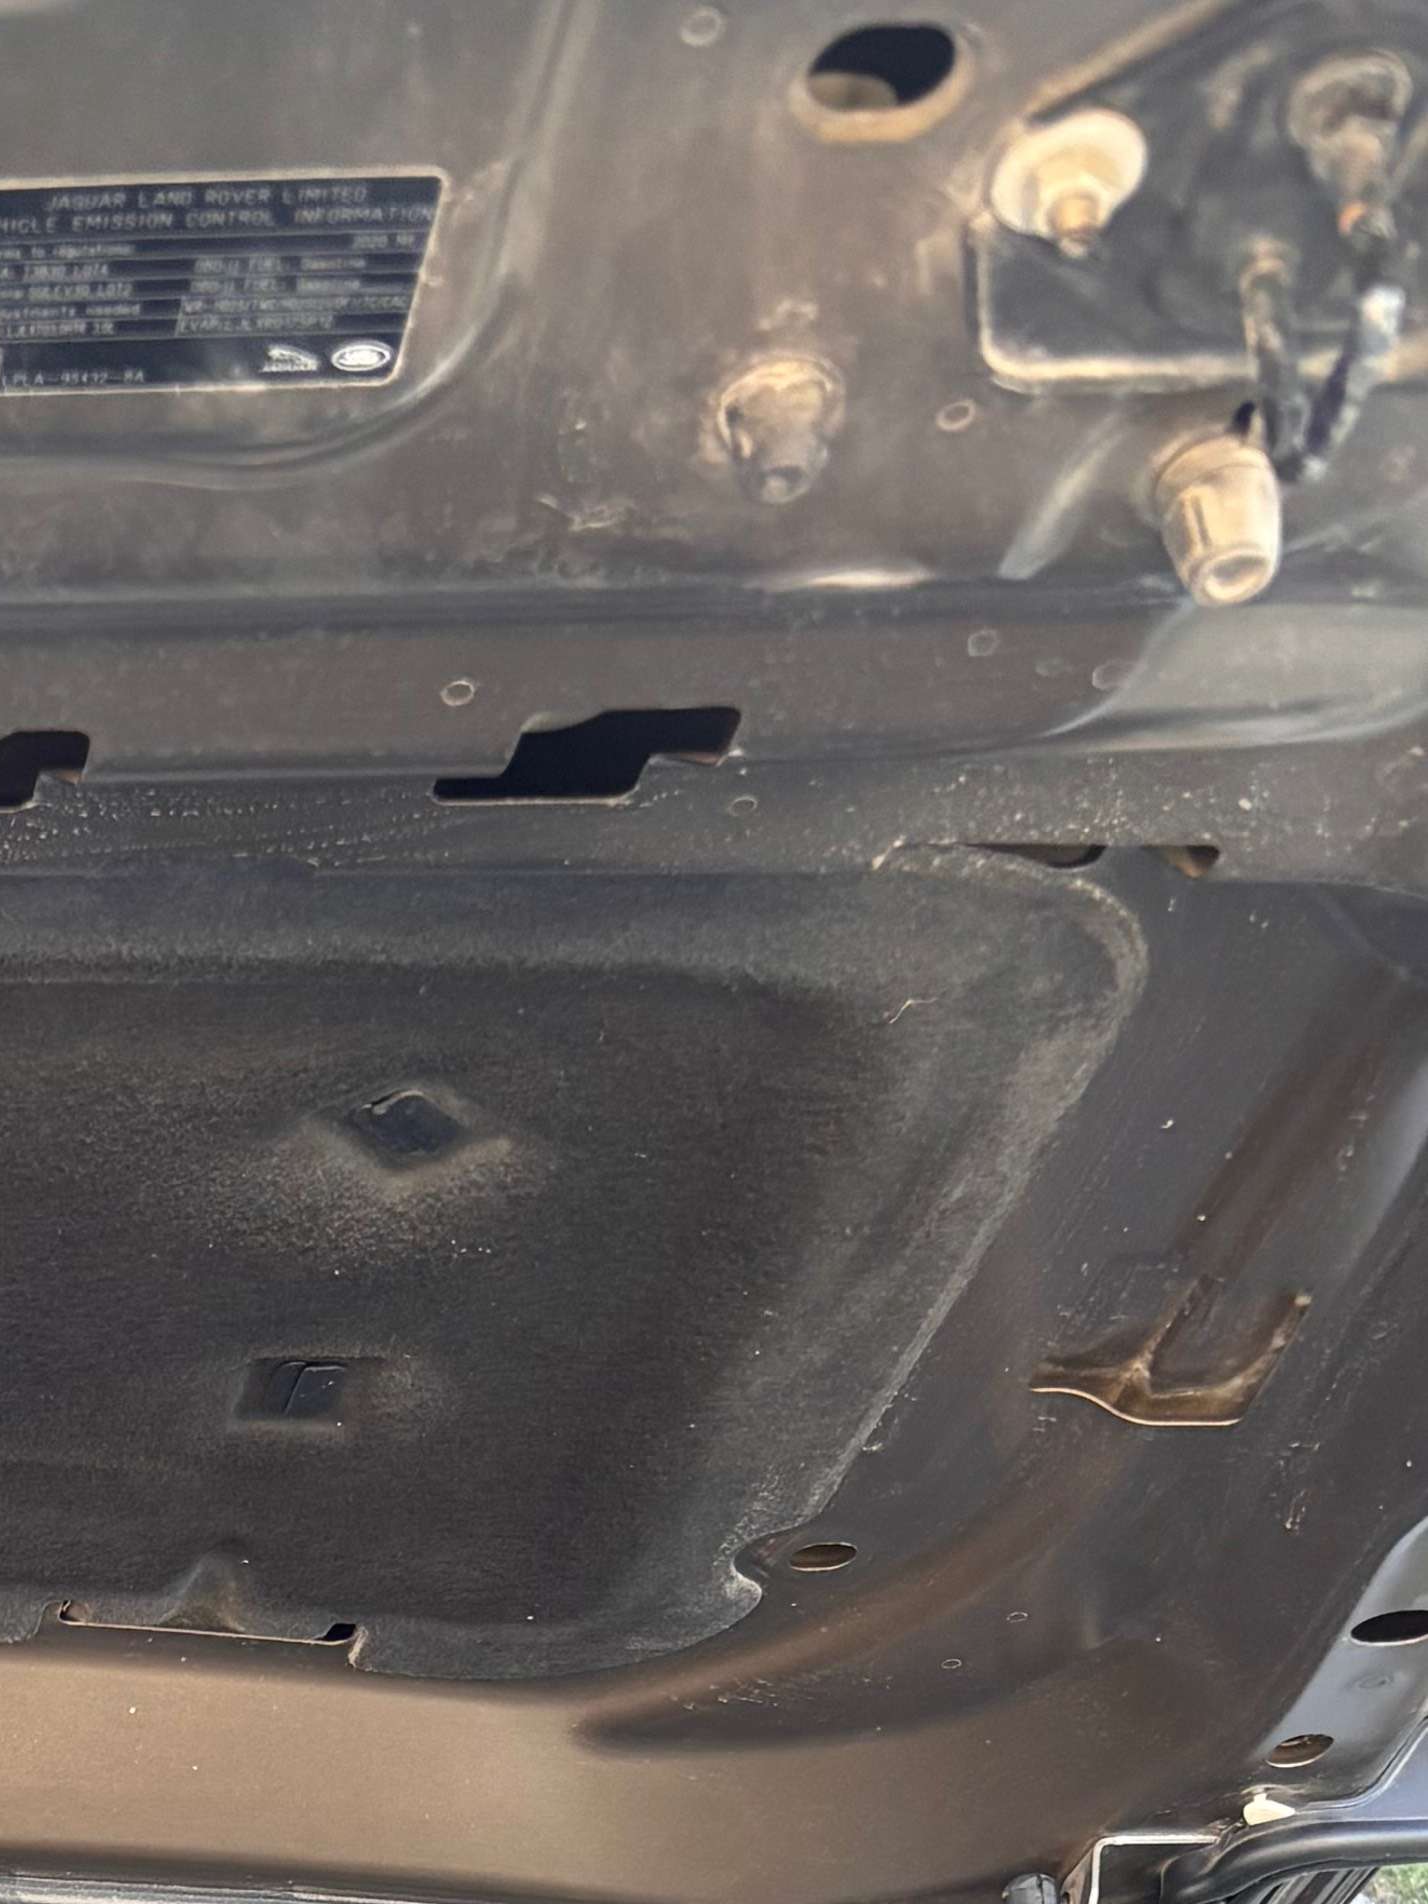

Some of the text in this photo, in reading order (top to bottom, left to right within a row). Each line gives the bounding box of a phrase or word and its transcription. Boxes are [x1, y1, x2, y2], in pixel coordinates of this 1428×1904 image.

[50, 184, 369, 210] JAGUAR LAND ROVER LIMITED
[72, 213, 174, 232] EMISSION
[185, 208, 276, 228] CONTROL
[294, 204, 432, 225] INFORMATION
